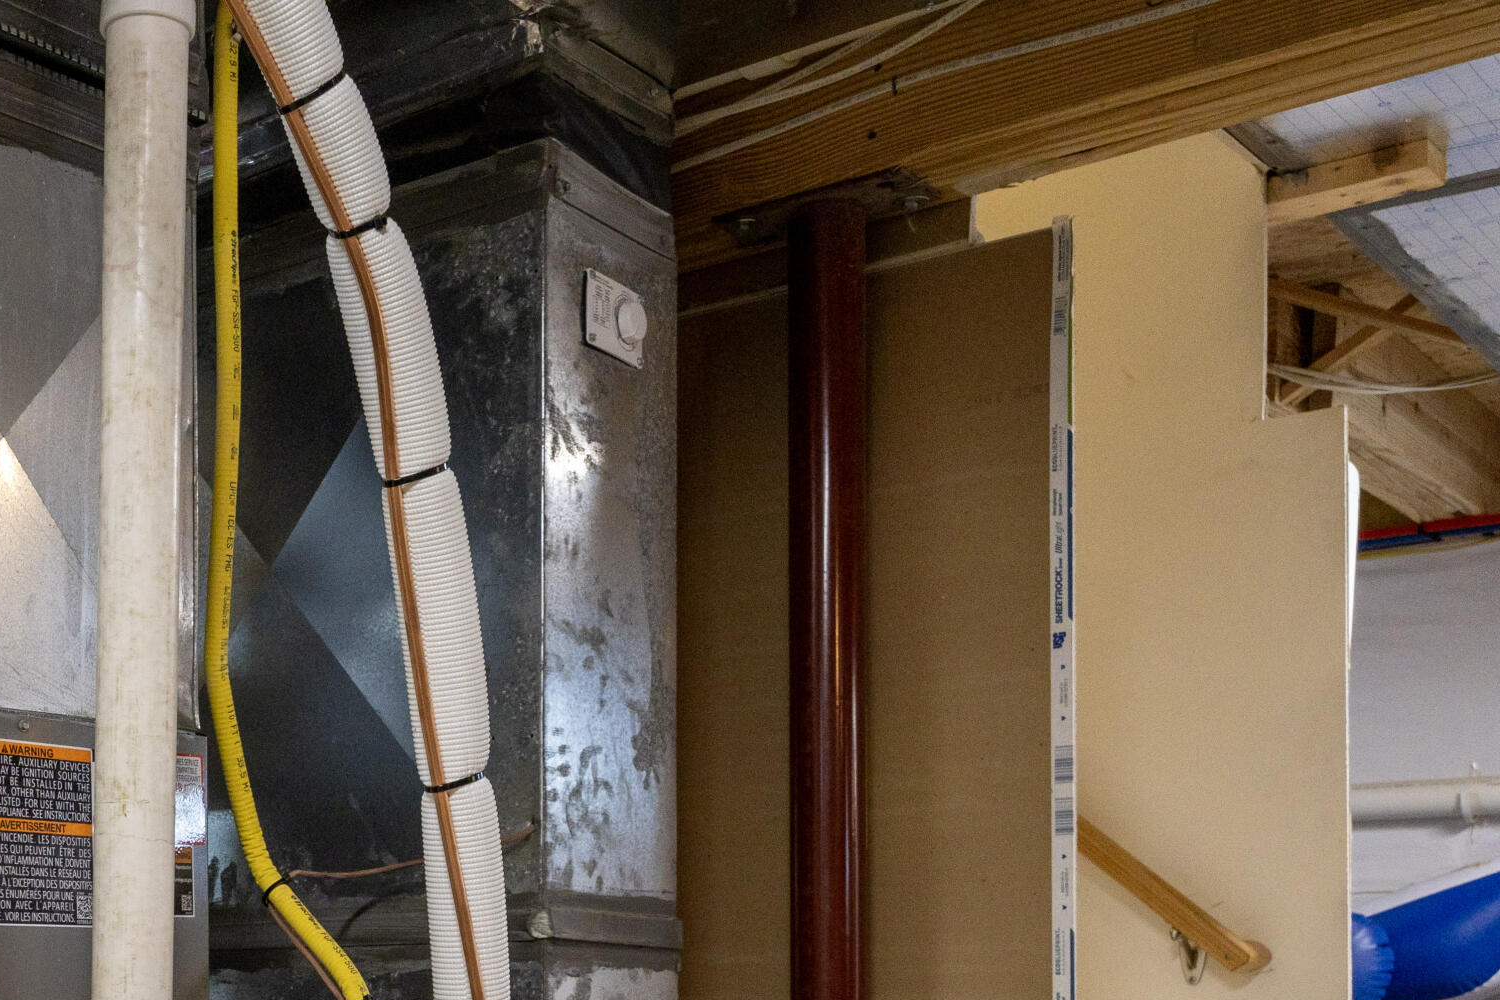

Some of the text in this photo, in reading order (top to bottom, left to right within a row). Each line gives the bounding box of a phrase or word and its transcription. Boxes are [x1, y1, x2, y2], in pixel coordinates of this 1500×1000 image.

[1054, 569, 1063, 625] SHEETROCK
[9, 745, 54, 758] WARNING
[19, 757, 58, 769] AUXILIARY
[60, 761, 90, 773] DEVICES
[11, 767, 20, 776] BE
[22, 768, 54, 779] IGNITION
[58, 772, 90, 783] SOURCES
[10, 777, 18, 786] BE
[23, 779, 63, 790] INSTALLED
[65, 782, 72, 791] IN
[77, 783, 90, 793] THE
[11, 787, 34, 798] OTHER
[36, 789, 55, 799] THAN
[57, 791, 91, 802] AUXILIARY
[25, 799, 38, 808] FOR
[40, 800, 53, 809] USE
[55, 802, 74, 811] WITH
[79, 803, 91, 813] THE
[33, 809, 44, 819] SEE
[45, 811, 91, 823] INSTRUCTIONS.
[0, 820, 66, 833] AVERTISSEMENT
[38, 836, 49, 844] LES
[52, 836, 91, 847] DISPOSITIFS
[10, 845, 23, 854] QUI
[25, 846, 55, 856] PEUVENT
[79, 849, 91, 858] DES
[55, 858, 63, 867] NE
[65, 859, 90, 868] DOIVENT
[31, 867, 48, 877] DANS
[50, 869, 57, 878] LE
[83, 870, 91, 880] DE
[46, 880, 58, 889] DES
[60, 881, 92, 891] DISPOSITIFS
[43, 890, 60, 900] POUR
[61, 892, 74, 901] UNE
[15, 900, 32, 910] AVEC
[5, 912, 20, 921] VOIR
[21, 912, 30, 922] LES
